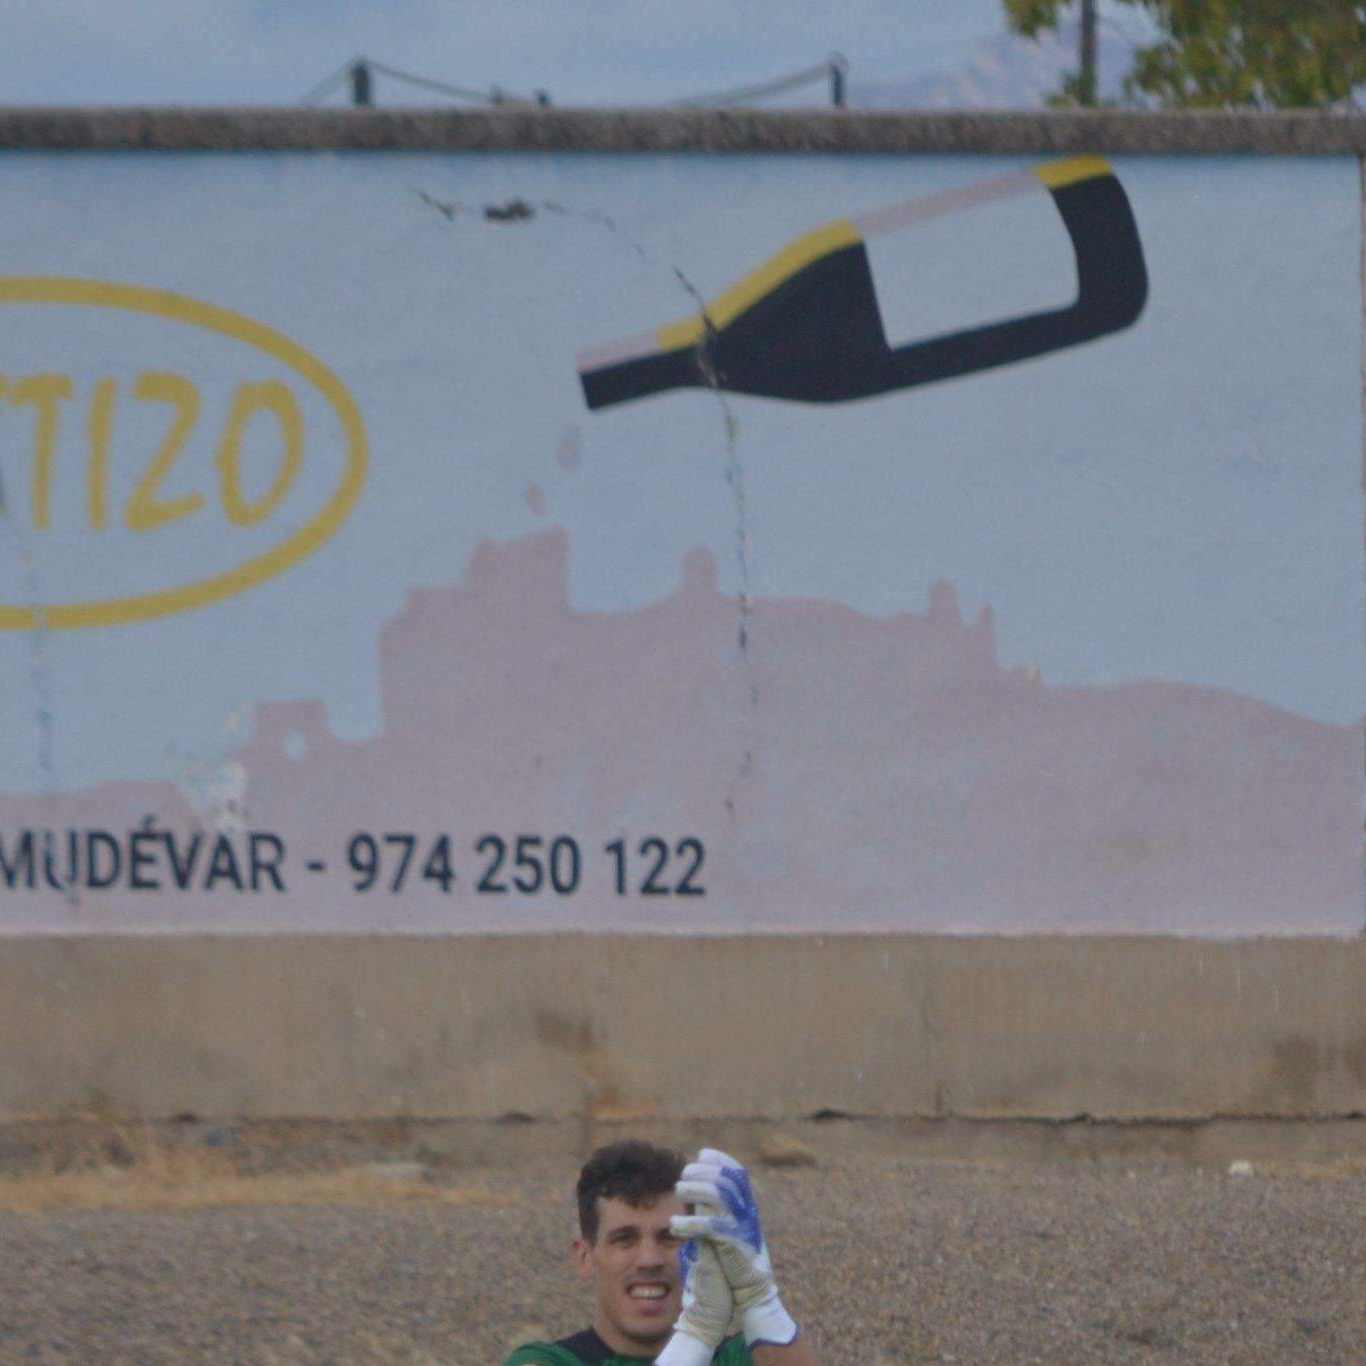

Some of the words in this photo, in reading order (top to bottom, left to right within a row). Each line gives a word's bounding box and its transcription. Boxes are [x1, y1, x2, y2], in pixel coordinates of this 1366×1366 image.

[346, 832, 456, 894] 974
[474, 835, 581, 896] 250
[603, 837, 706, 898] 122
